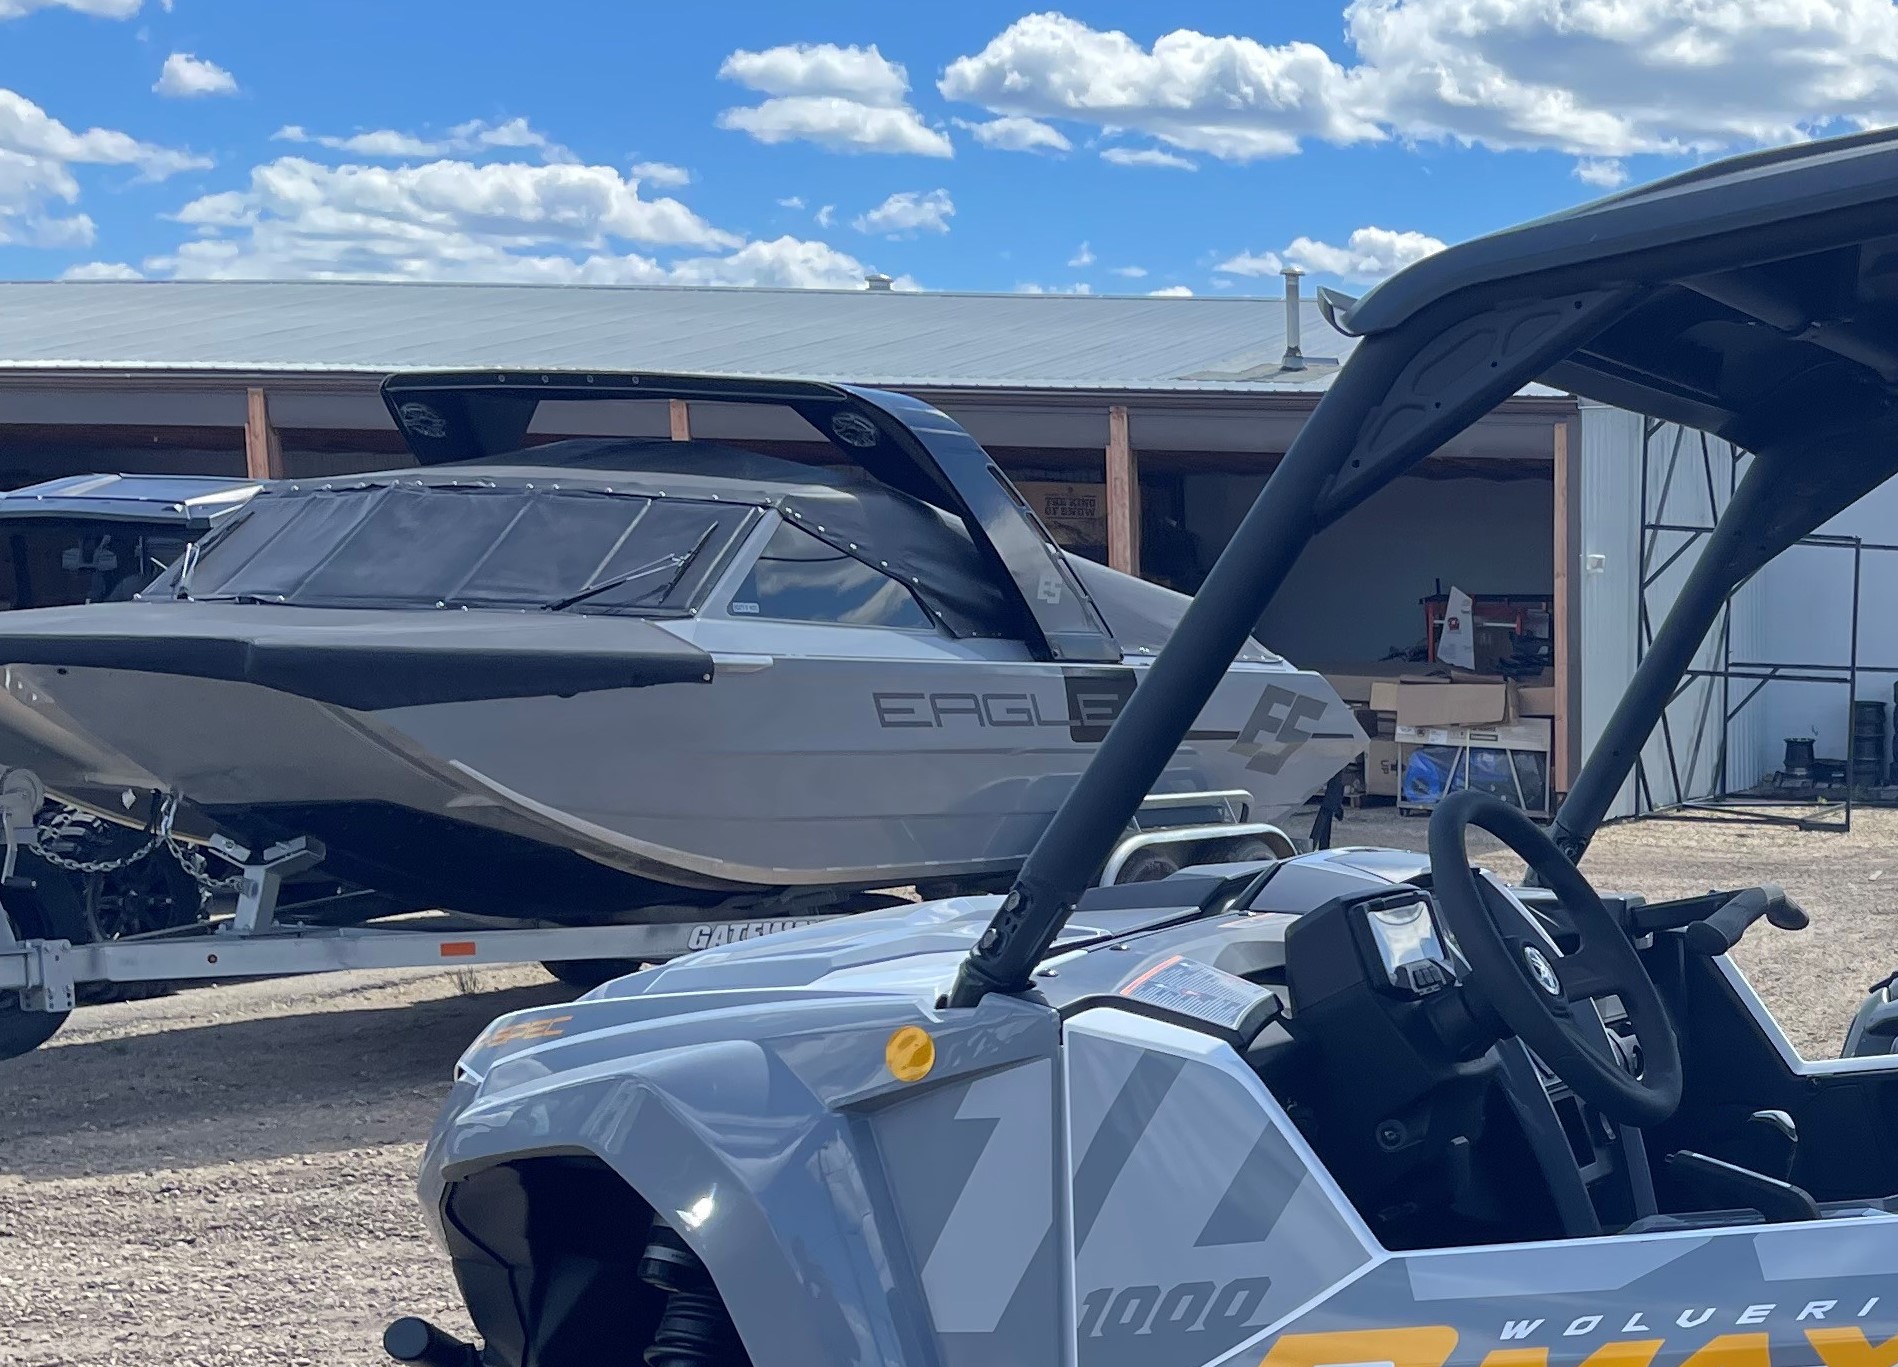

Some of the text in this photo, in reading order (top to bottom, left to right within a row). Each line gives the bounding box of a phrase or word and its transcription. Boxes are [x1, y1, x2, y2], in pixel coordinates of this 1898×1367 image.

[872, 692, 1128, 728] EAGLE
[687, 919, 825, 951] GATE
[1080, 1276, 1272, 1338] 1000
